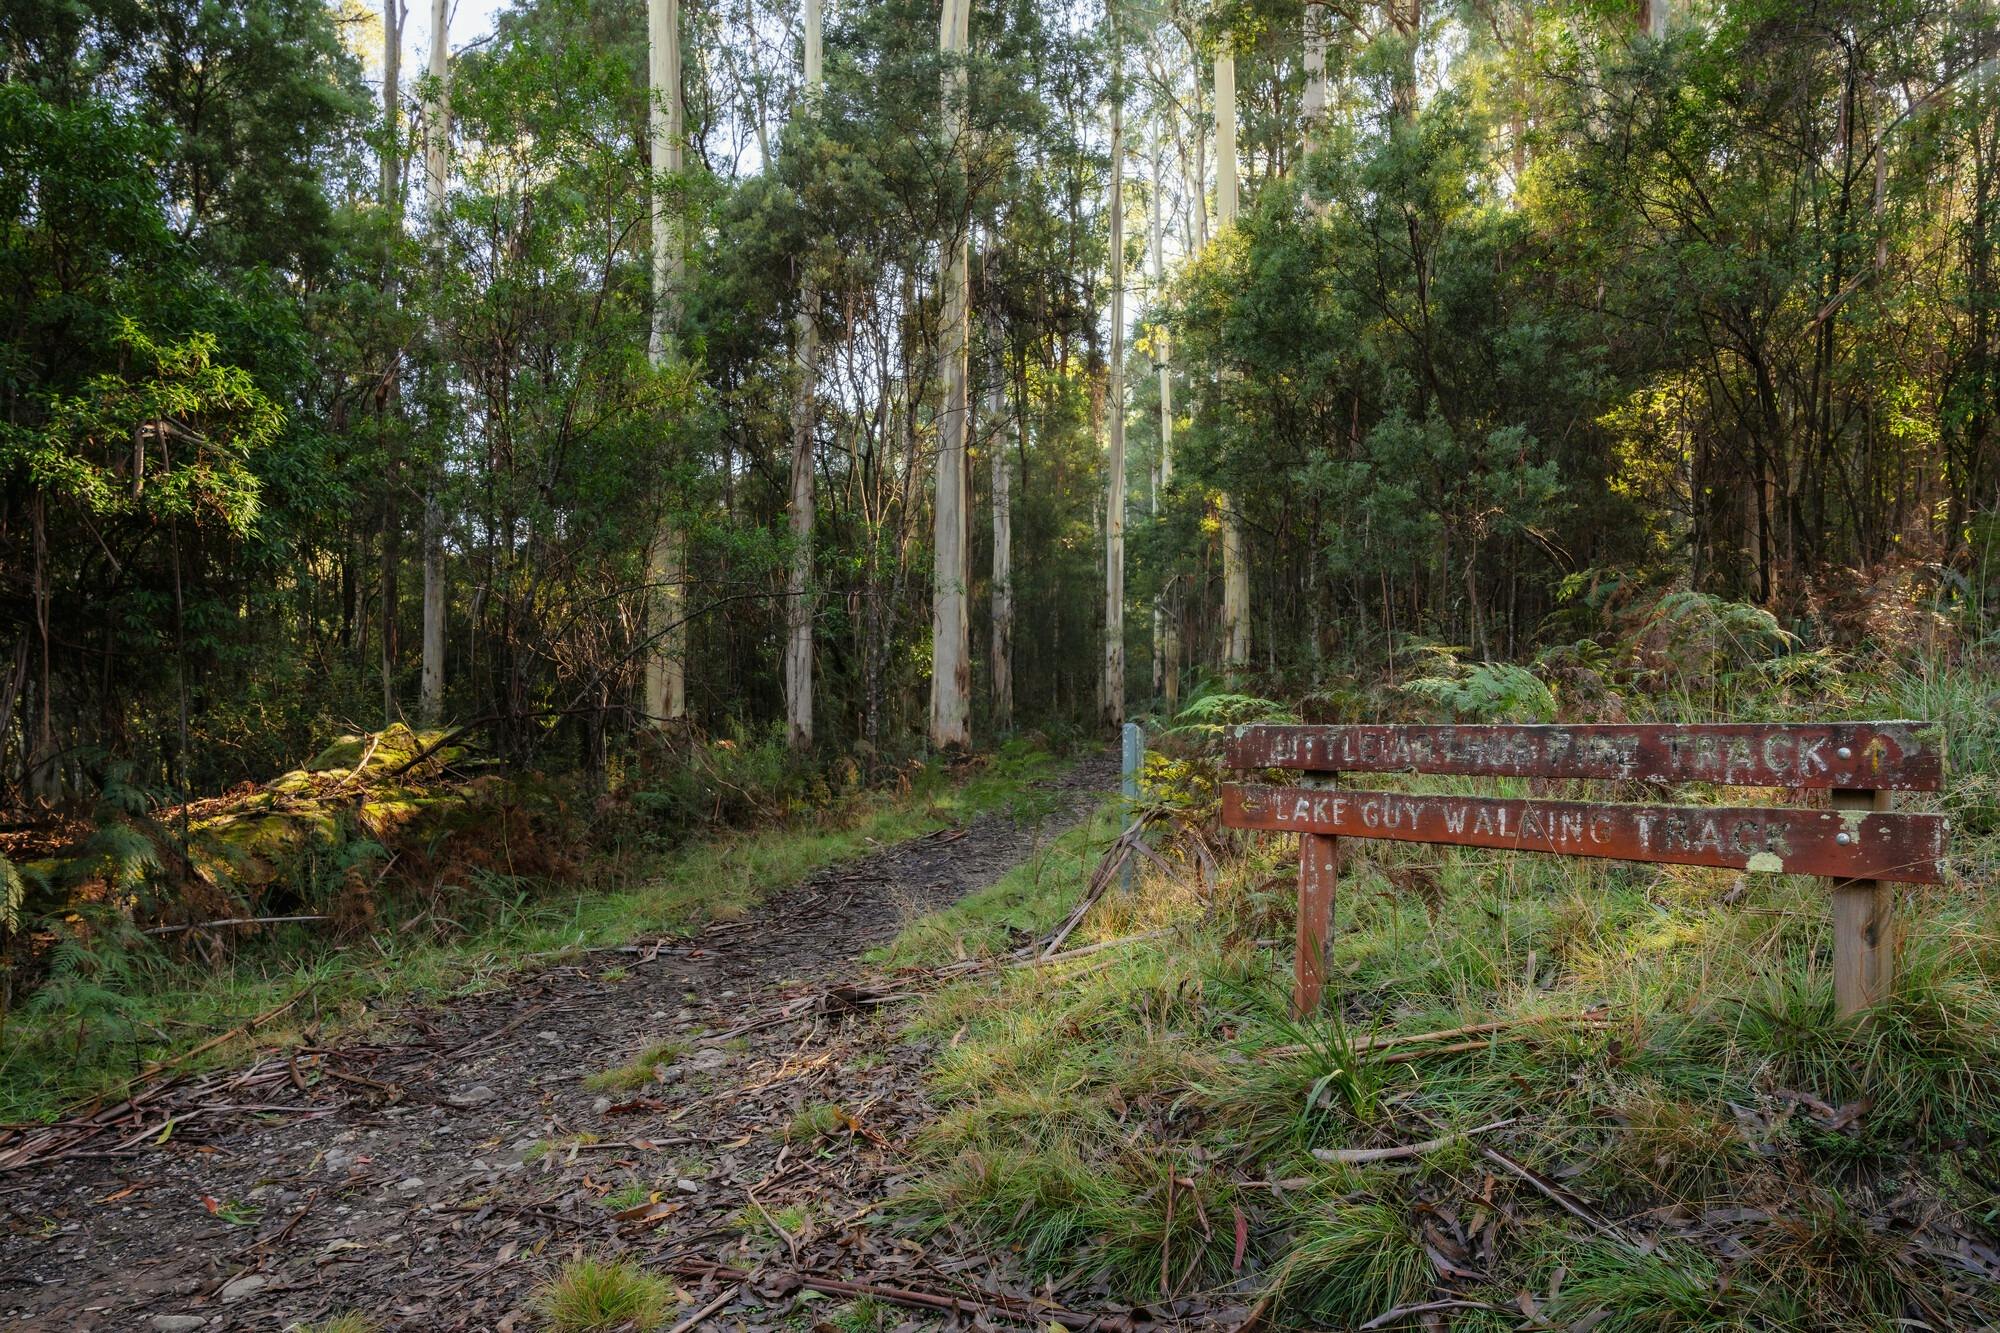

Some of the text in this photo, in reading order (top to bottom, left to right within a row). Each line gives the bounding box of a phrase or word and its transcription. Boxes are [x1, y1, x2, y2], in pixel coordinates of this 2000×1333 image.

[1660, 734, 1829, 774] TRACK
[1275, 794, 1792, 856] LAKE GUY WALKING TRACK
